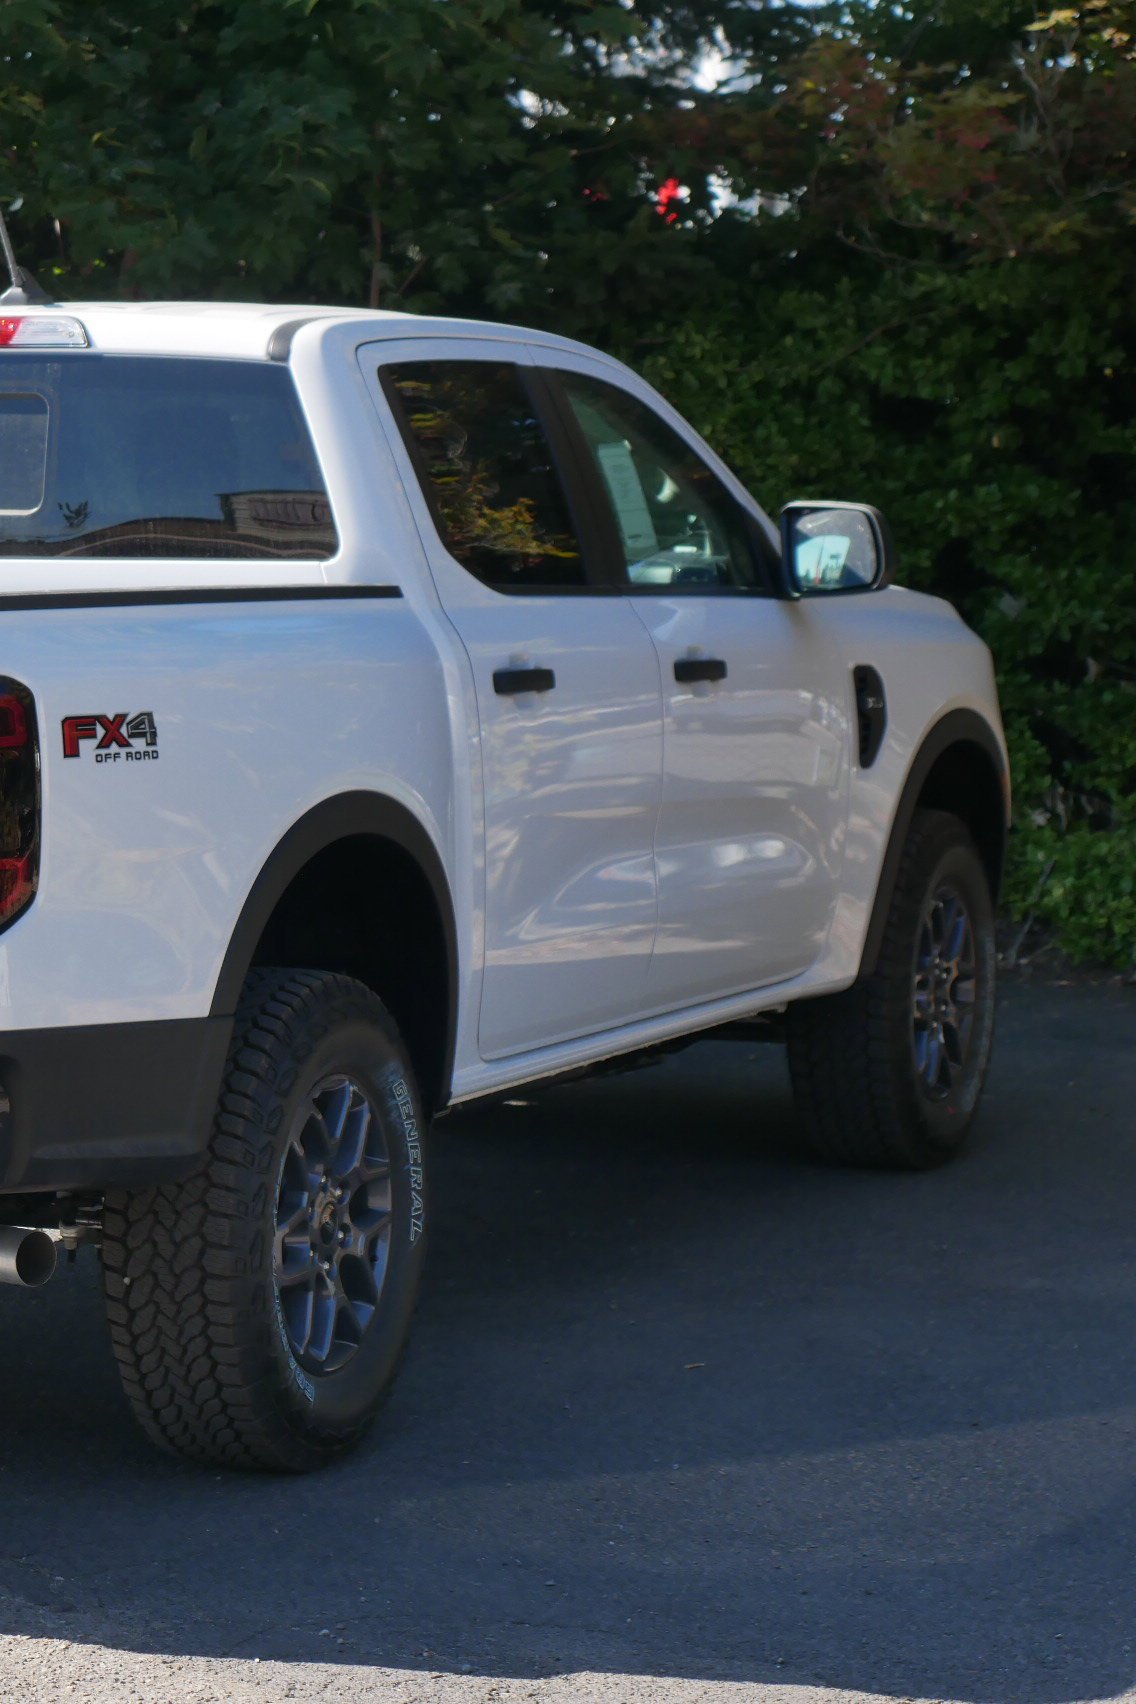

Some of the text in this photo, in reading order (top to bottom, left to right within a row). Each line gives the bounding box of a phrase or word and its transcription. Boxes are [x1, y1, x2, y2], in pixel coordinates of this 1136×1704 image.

[61, 711, 158, 758] FX4
[95, 749, 159, 763] OFF ROAD
[390, 1078, 424, 1242] GENERAL
